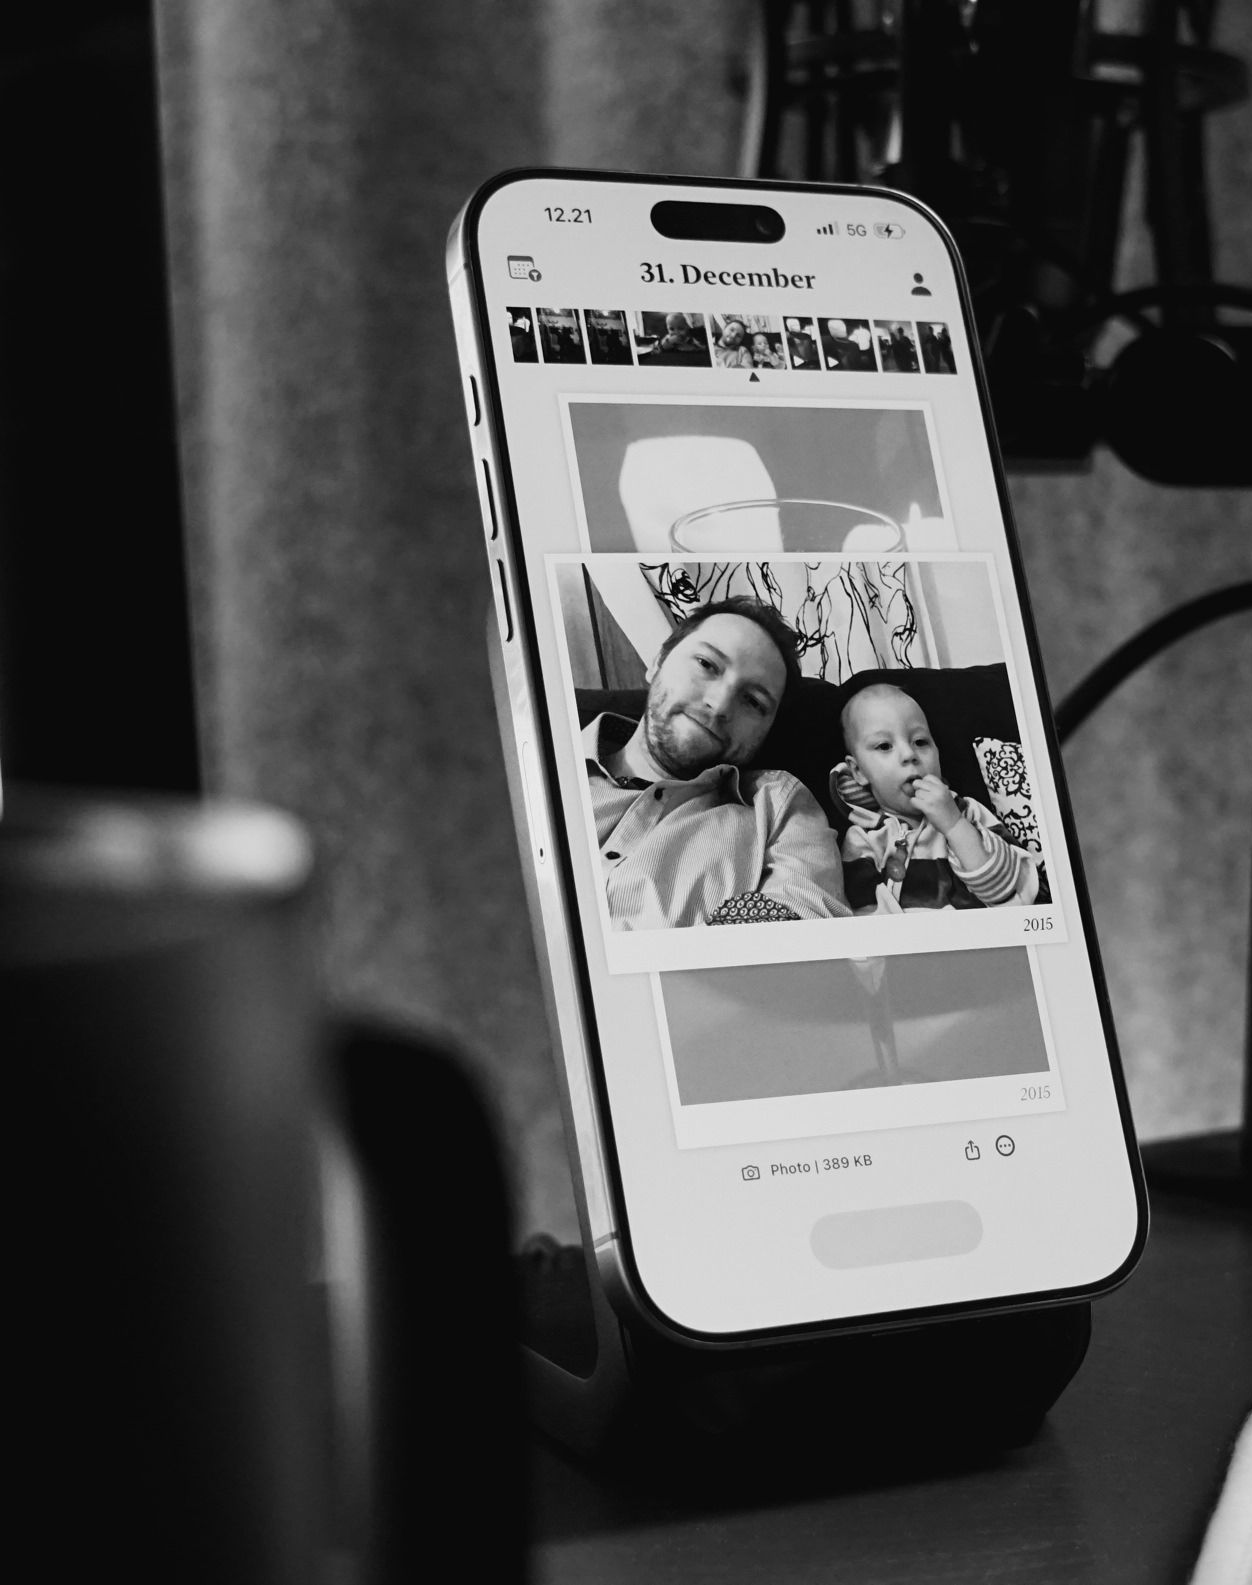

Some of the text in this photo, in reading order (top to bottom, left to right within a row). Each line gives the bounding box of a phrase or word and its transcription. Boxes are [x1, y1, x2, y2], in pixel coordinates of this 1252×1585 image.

[544, 207, 593, 224] 12.21
[846, 223, 868, 238] 5G
[639, 262, 817, 291] 31. December
[1023, 916, 1054, 932] 2015
[1020, 1085, 1051, 1102] 2015
[770, 1162, 811, 1177] Photo
[822, 1156, 850, 1171] 389
[853, 1154, 873, 1168] KB
